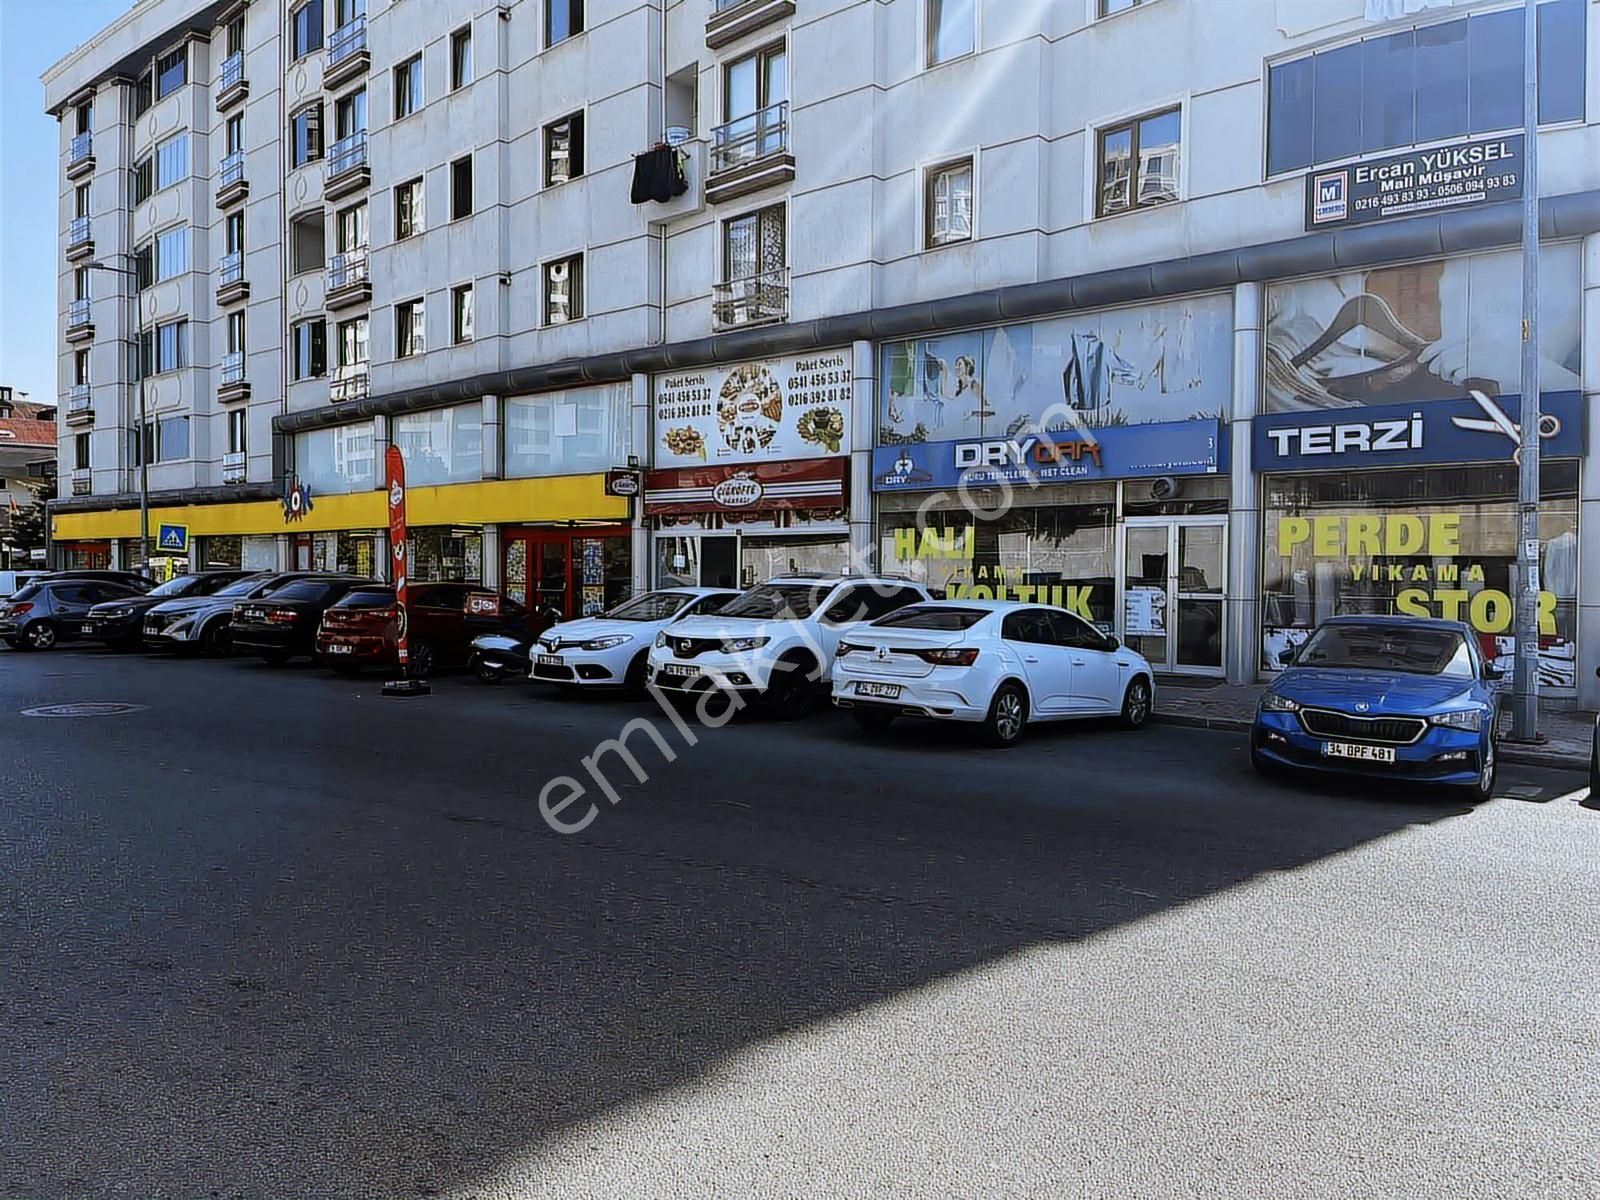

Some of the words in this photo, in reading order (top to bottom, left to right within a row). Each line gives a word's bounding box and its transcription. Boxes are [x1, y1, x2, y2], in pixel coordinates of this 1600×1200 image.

[1355, 161, 1415, 184] Ercan
[1421, 142, 1514, 172] YÜKSEL
[1418, 164, 1486, 186] Müşavir
[1355, 197, 1379, 211] 0216
[1381, 193, 1399, 206] 493
[1402, 190, 1414, 203] 83
[1416, 188, 1429, 201] 93
[1438, 183, 1463, 197] 0506
[1465, 179, 1484, 193] 094
[1487, 176, 1500, 189] 93
[1502, 174, 1516, 187] 83
[795, 360, 818, 372] Paket
[819, 354, 844, 369] Servis
[665, 378, 684, 389] Paket
[685, 373, 705, 387] Servis
[788, 375, 807, 390] 0541
[809, 372, 827, 387] 456
[828, 371, 839, 385] 53
[841, 369, 851, 383] 37
[788, 391, 808, 406] 0216
[809, 390, 826, 404] 392
[828, 388, 837, 402] 81
[840, 387, 851, 401] 82
[1267, 411, 1424, 457] TERZİ
[1060, 463, 1089, 477] CLEAN
[894, 525, 975, 561] HALI
[1278, 513, 1460, 556] PERDE
[1350, 564, 1485, 582] YIKAMA
[1396, 588, 1558, 636] STOR
[1328, 742, 1342, 755] 34
[1371, 747, 1392, 760] 481
